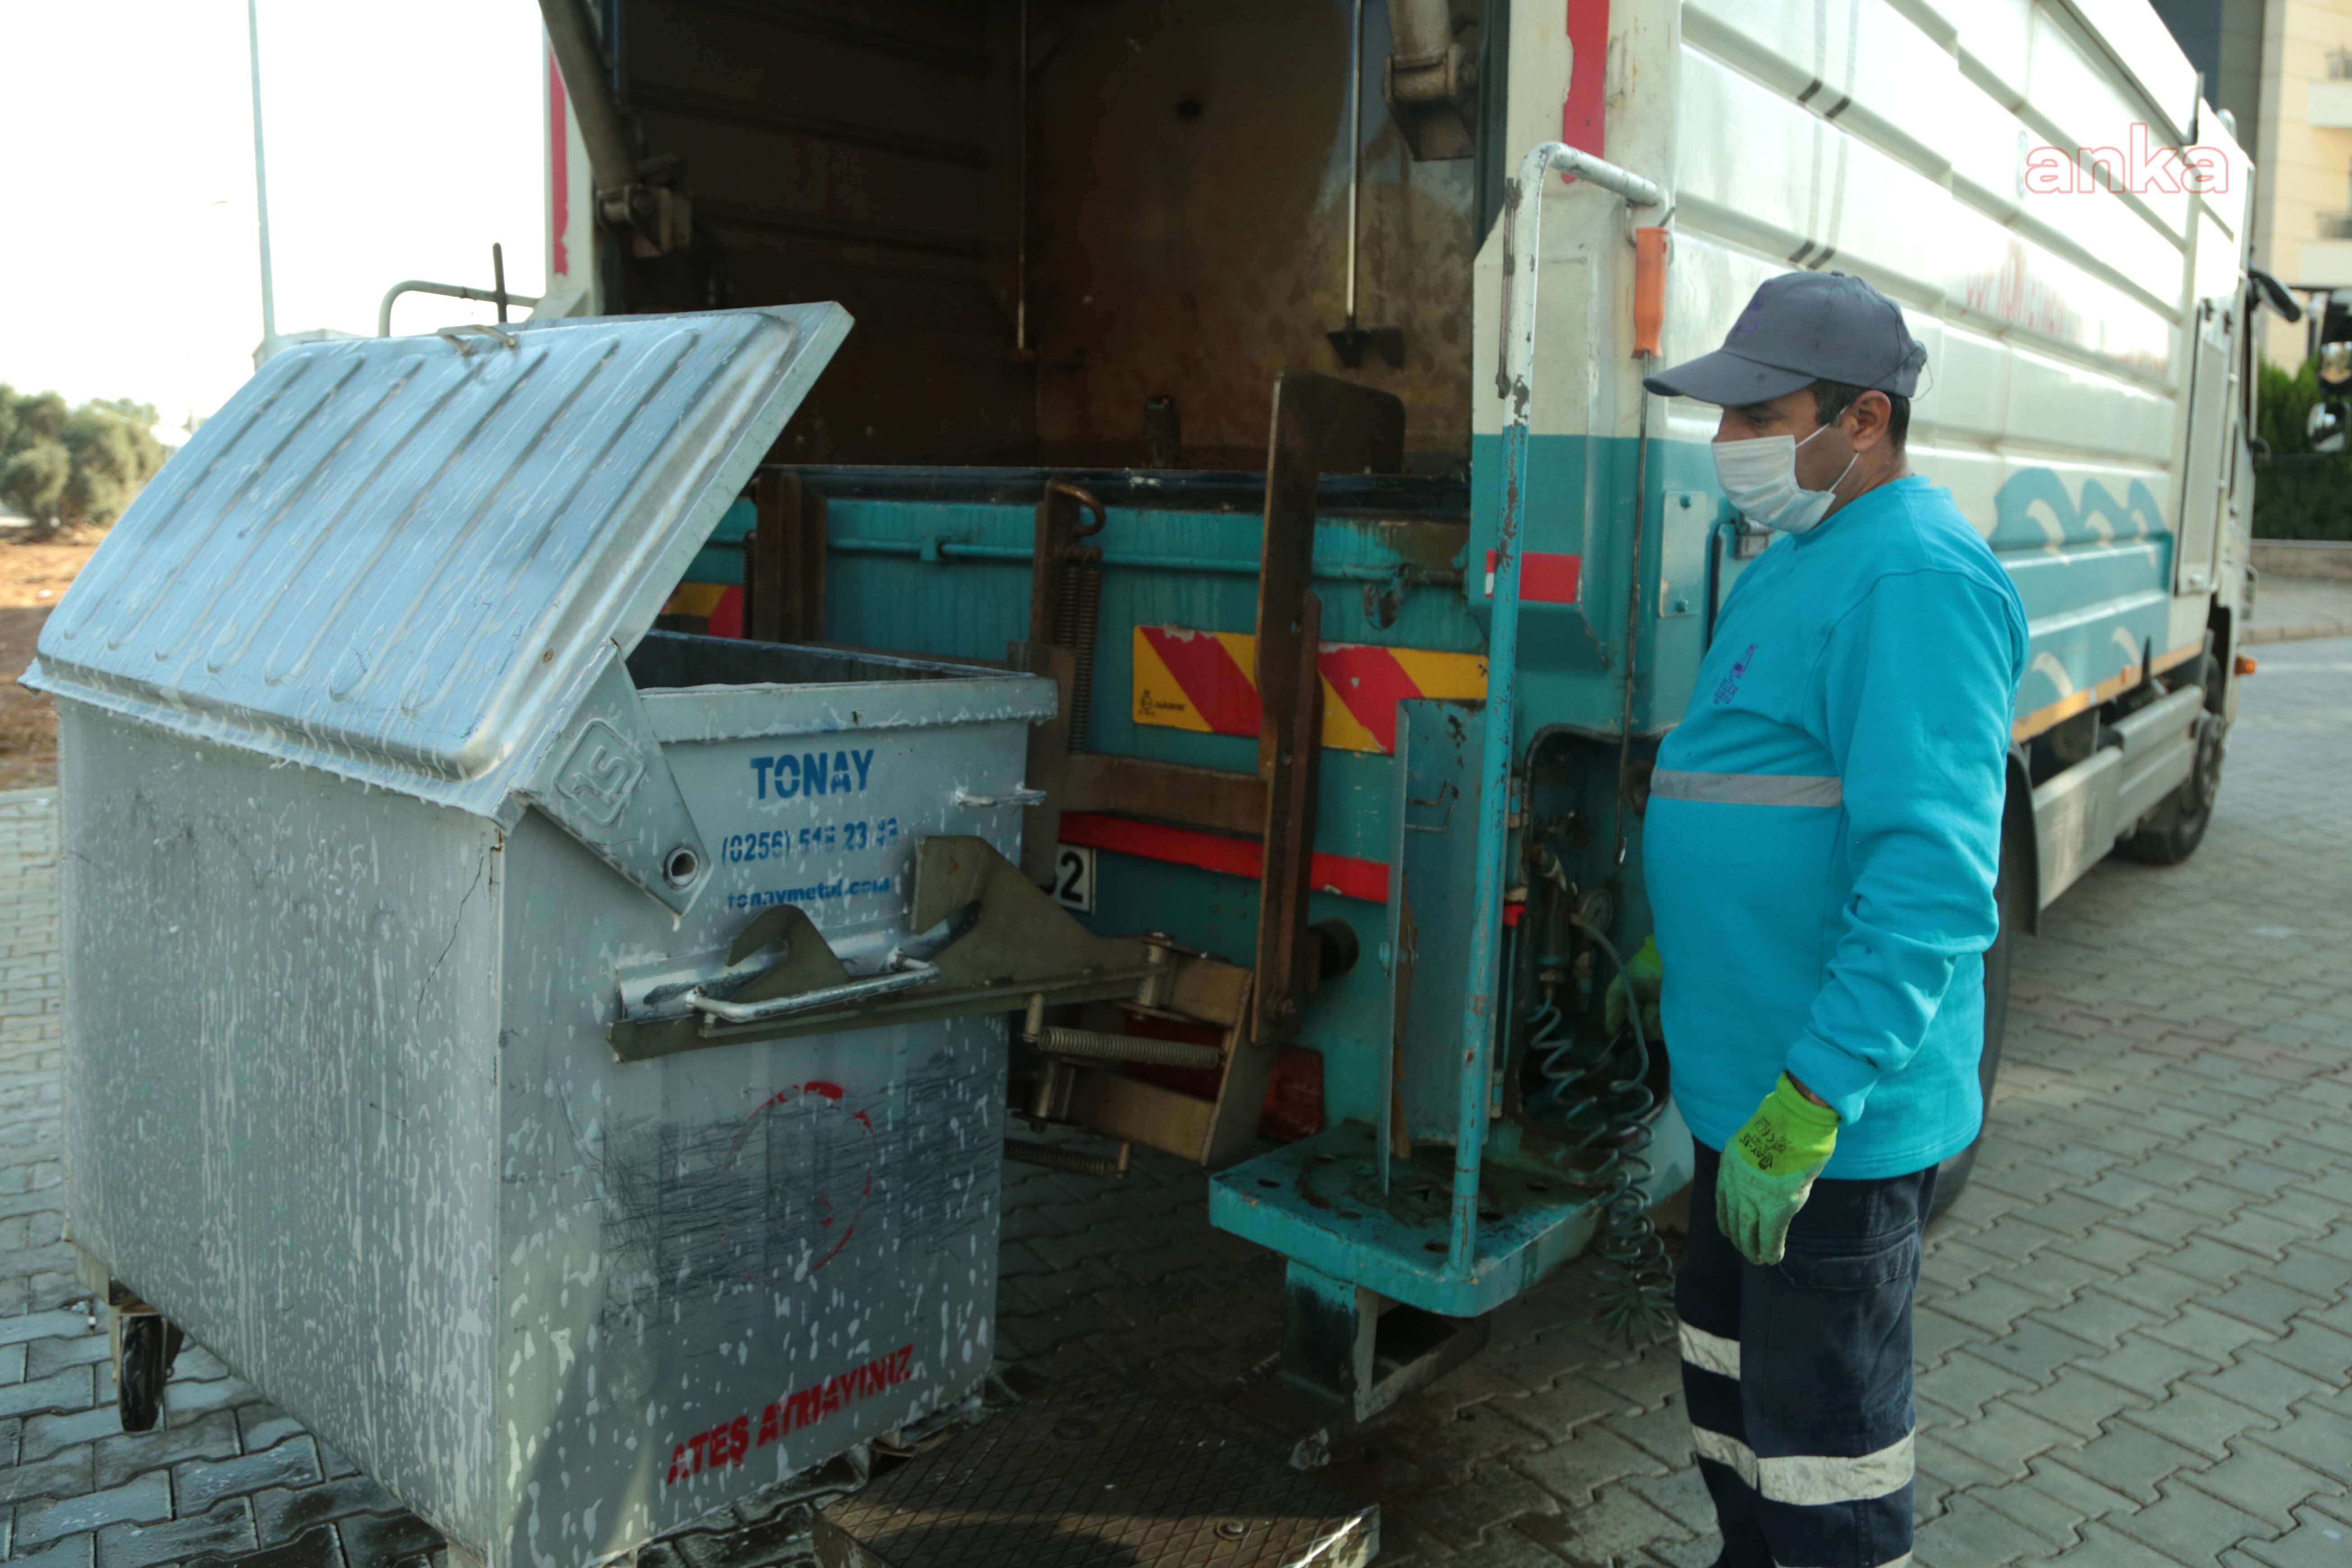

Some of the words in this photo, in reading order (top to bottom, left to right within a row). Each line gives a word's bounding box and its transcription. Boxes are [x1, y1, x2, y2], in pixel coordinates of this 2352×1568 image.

[751, 749, 874, 799] TONAY
[843, 820, 867, 851] 23
[667, 1415, 749, 1486] ATEŞ
[757, 1344, 913, 1448] ATMAYINIZ
